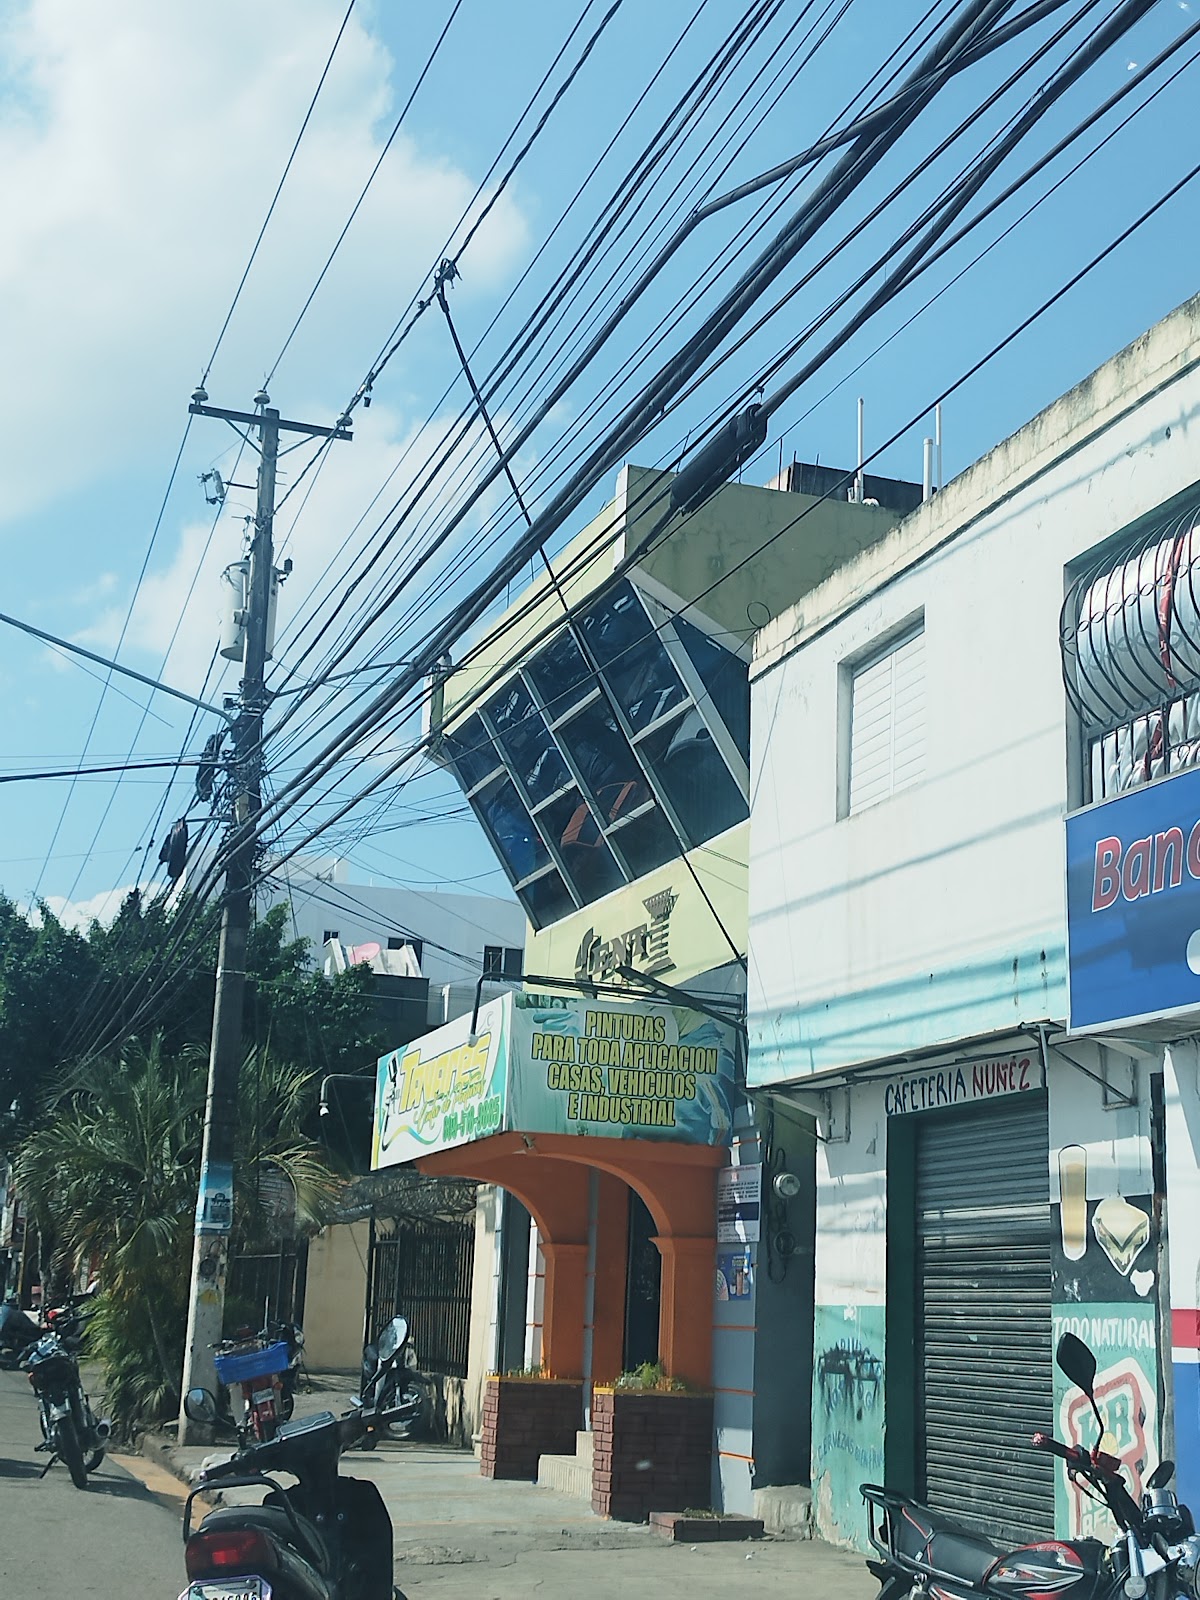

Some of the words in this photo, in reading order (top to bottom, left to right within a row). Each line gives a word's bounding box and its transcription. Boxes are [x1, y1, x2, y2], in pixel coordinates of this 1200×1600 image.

[585, 1010, 666, 1043] PINTURAS
[531, 1032, 575, 1063] PARA
[578, 1037, 621, 1067] TODA
[622, 1041, 718, 1074] APLICACION
[547, 1063, 606, 1096] CASAS,
[607, 1068, 696, 1100] VEHICULOS
[884, 1068, 966, 1115] CAFETERIA
[567, 1093, 579, 1120] E
[580, 1094, 676, 1127] INDUSTRIAL
